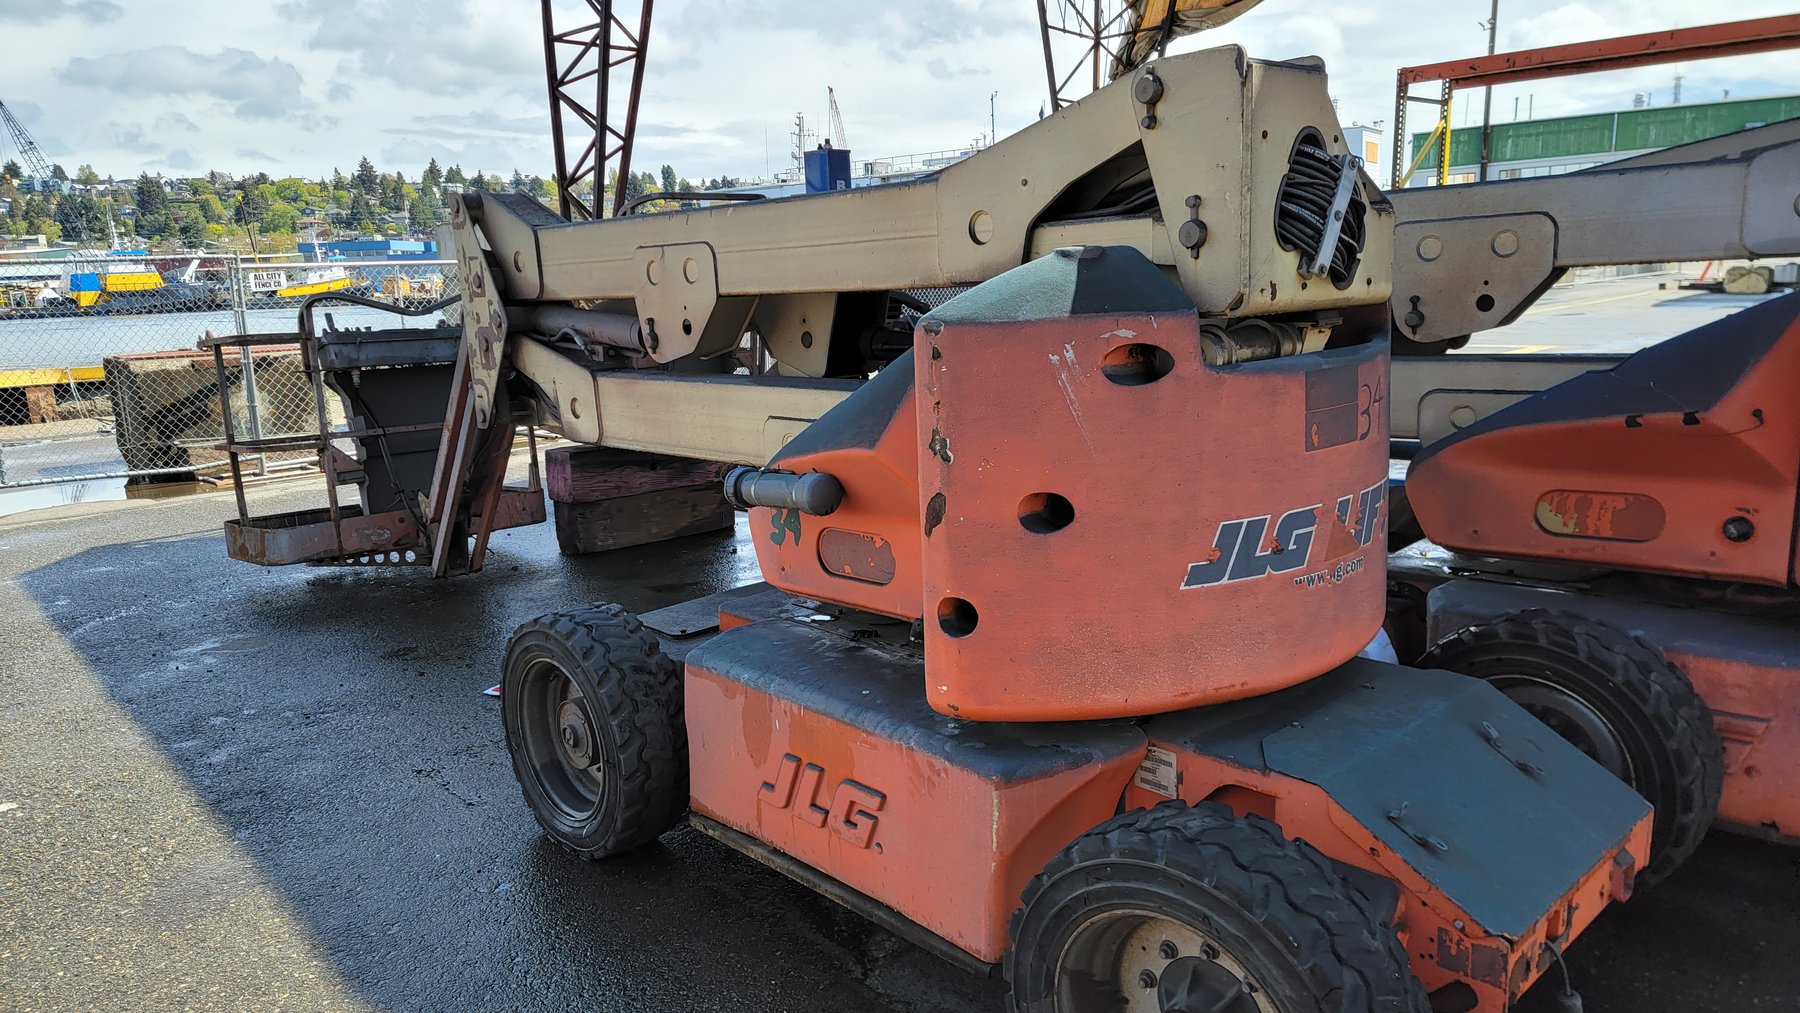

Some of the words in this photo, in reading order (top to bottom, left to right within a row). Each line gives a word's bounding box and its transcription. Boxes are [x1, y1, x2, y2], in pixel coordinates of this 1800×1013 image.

[253, 273, 265, 281] ALL
[266, 272, 282, 280] CITY
[254, 281, 272, 289] FENCE
[1359, 374, 1384, 441] 34
[1180, 503, 1323, 590] JLG
